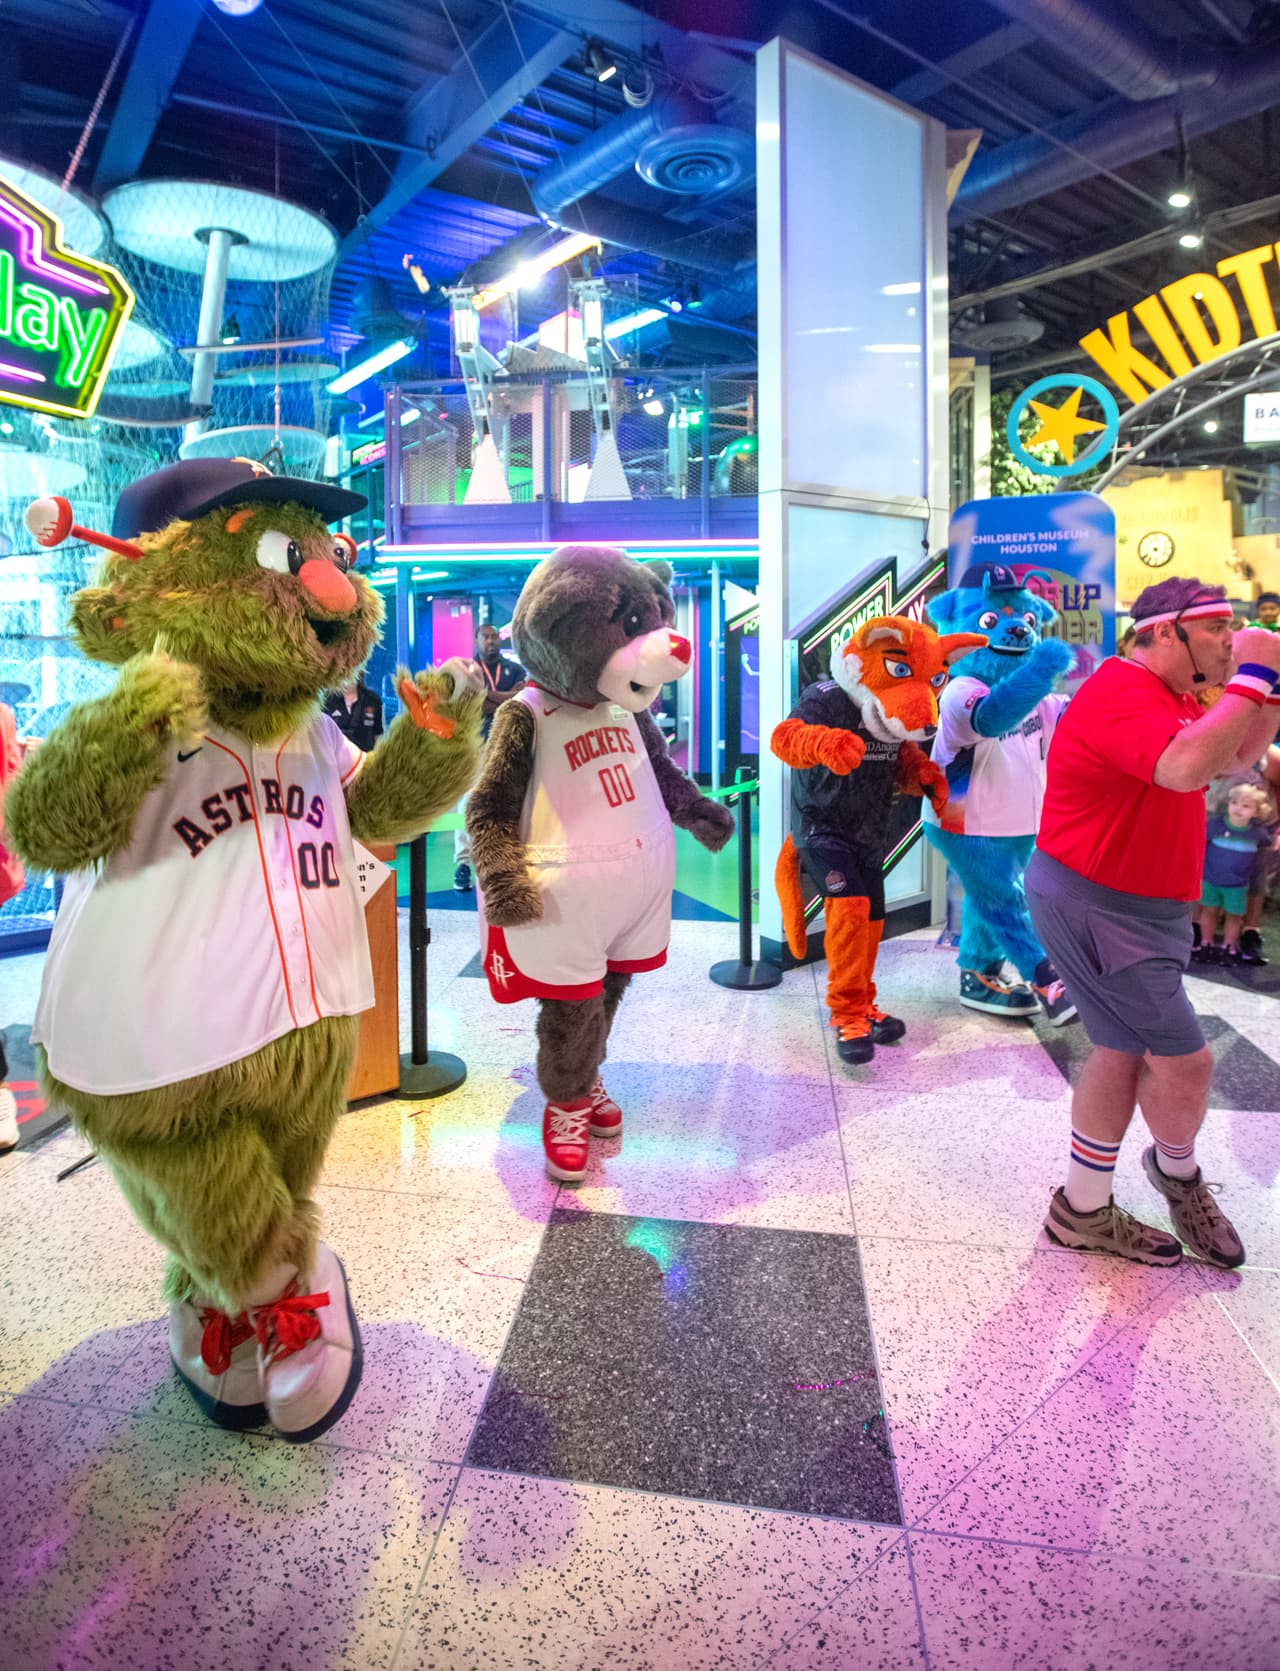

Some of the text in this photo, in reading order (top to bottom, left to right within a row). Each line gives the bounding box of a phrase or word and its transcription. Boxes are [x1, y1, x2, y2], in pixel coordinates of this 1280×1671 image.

[1078, 240, 1280, 407] KIDT
[1255, 406, 1280, 420] BA
[971, 529, 1089, 545] CHILDREN'S MUSEUM
[1000, 542, 1057, 555] HOUSTON
[1062, 583, 1101, 611] UP
[830, 594, 884, 655] POWER
[564, 726, 636, 772] ROCKETS
[598, 763, 636, 808] 00
[172, 778, 326, 859] ASTROS
[298, 841, 341, 890] 00
